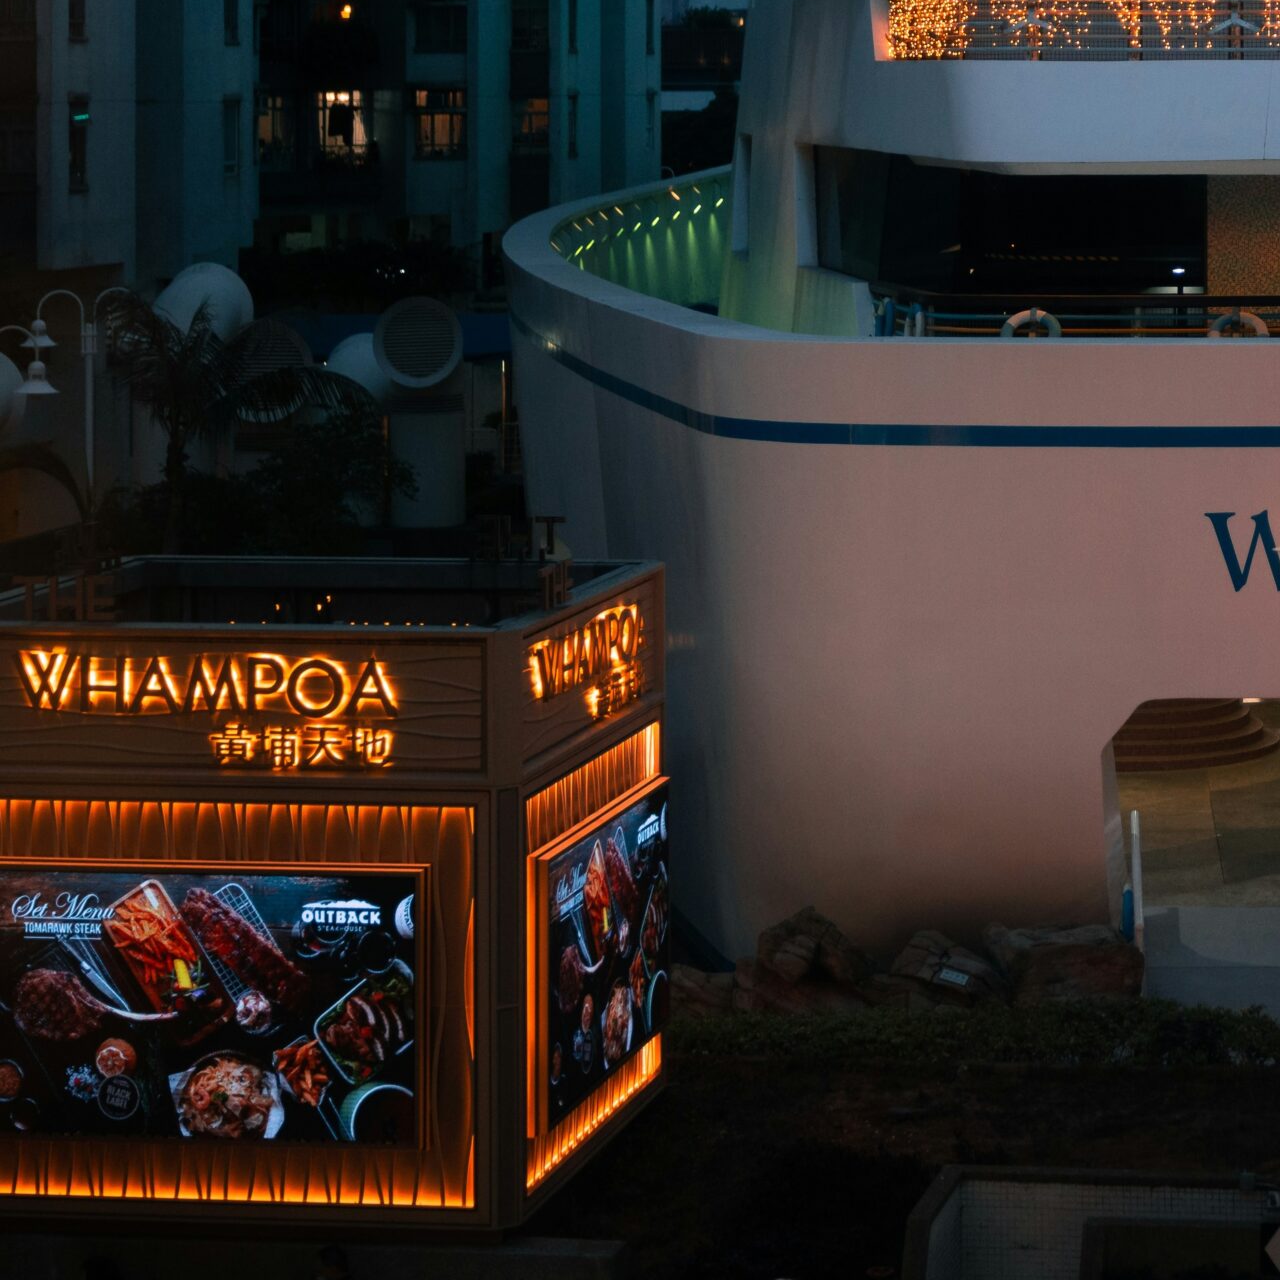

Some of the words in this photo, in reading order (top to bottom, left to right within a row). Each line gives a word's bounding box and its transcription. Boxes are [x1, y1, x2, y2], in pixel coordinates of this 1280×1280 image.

[530, 602, 648, 703] WHAMPOA
[16, 648, 400, 719] WHAMPOA
[209, 724, 395, 769] 黃埔天地
[11, 891, 49, 923] Set
[51, 891, 116, 920] Menu
[301, 910, 381, 925] OUTBACK
[74, 923, 102, 935] STEAK
